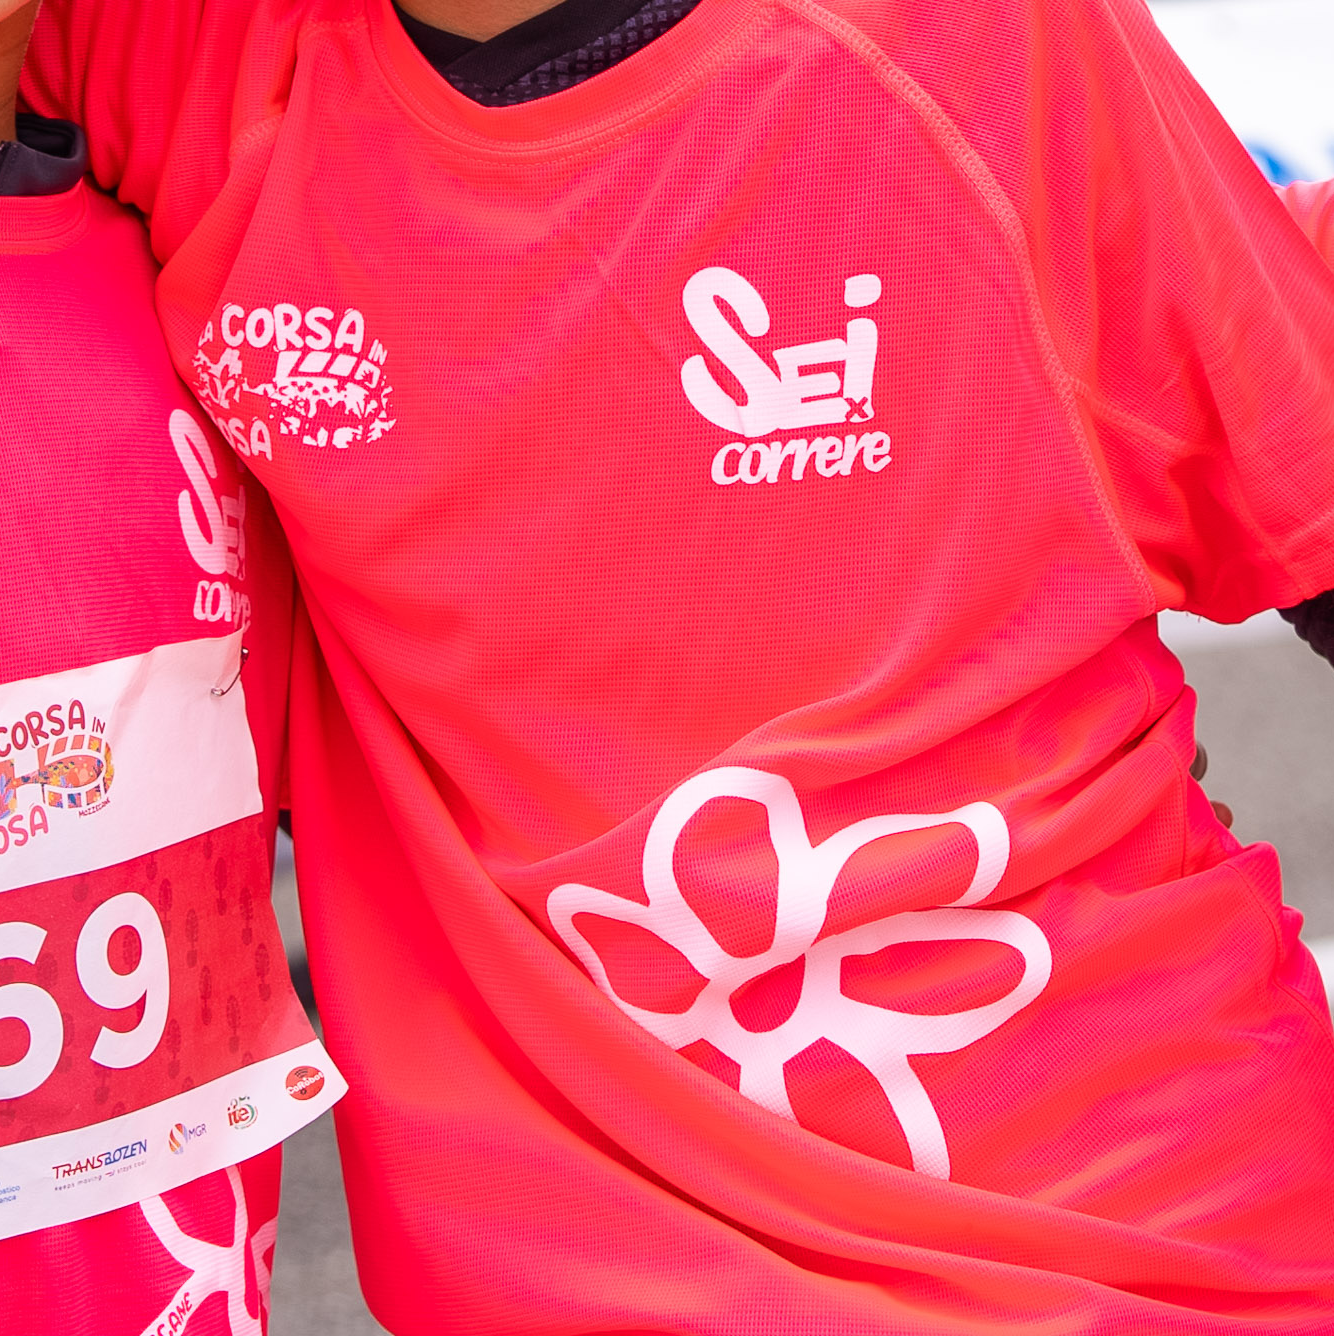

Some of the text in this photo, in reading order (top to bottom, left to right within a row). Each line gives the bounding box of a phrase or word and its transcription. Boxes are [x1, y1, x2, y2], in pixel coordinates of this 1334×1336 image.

[221, 303, 364, 354] CORSA
[368, 339, 387, 366] IN
[209, 409, 272, 461] OSA
[711, 430, 892, 485] correre
[92, 717, 105, 734] IN
[188, 1123, 207, 1140] MGR
